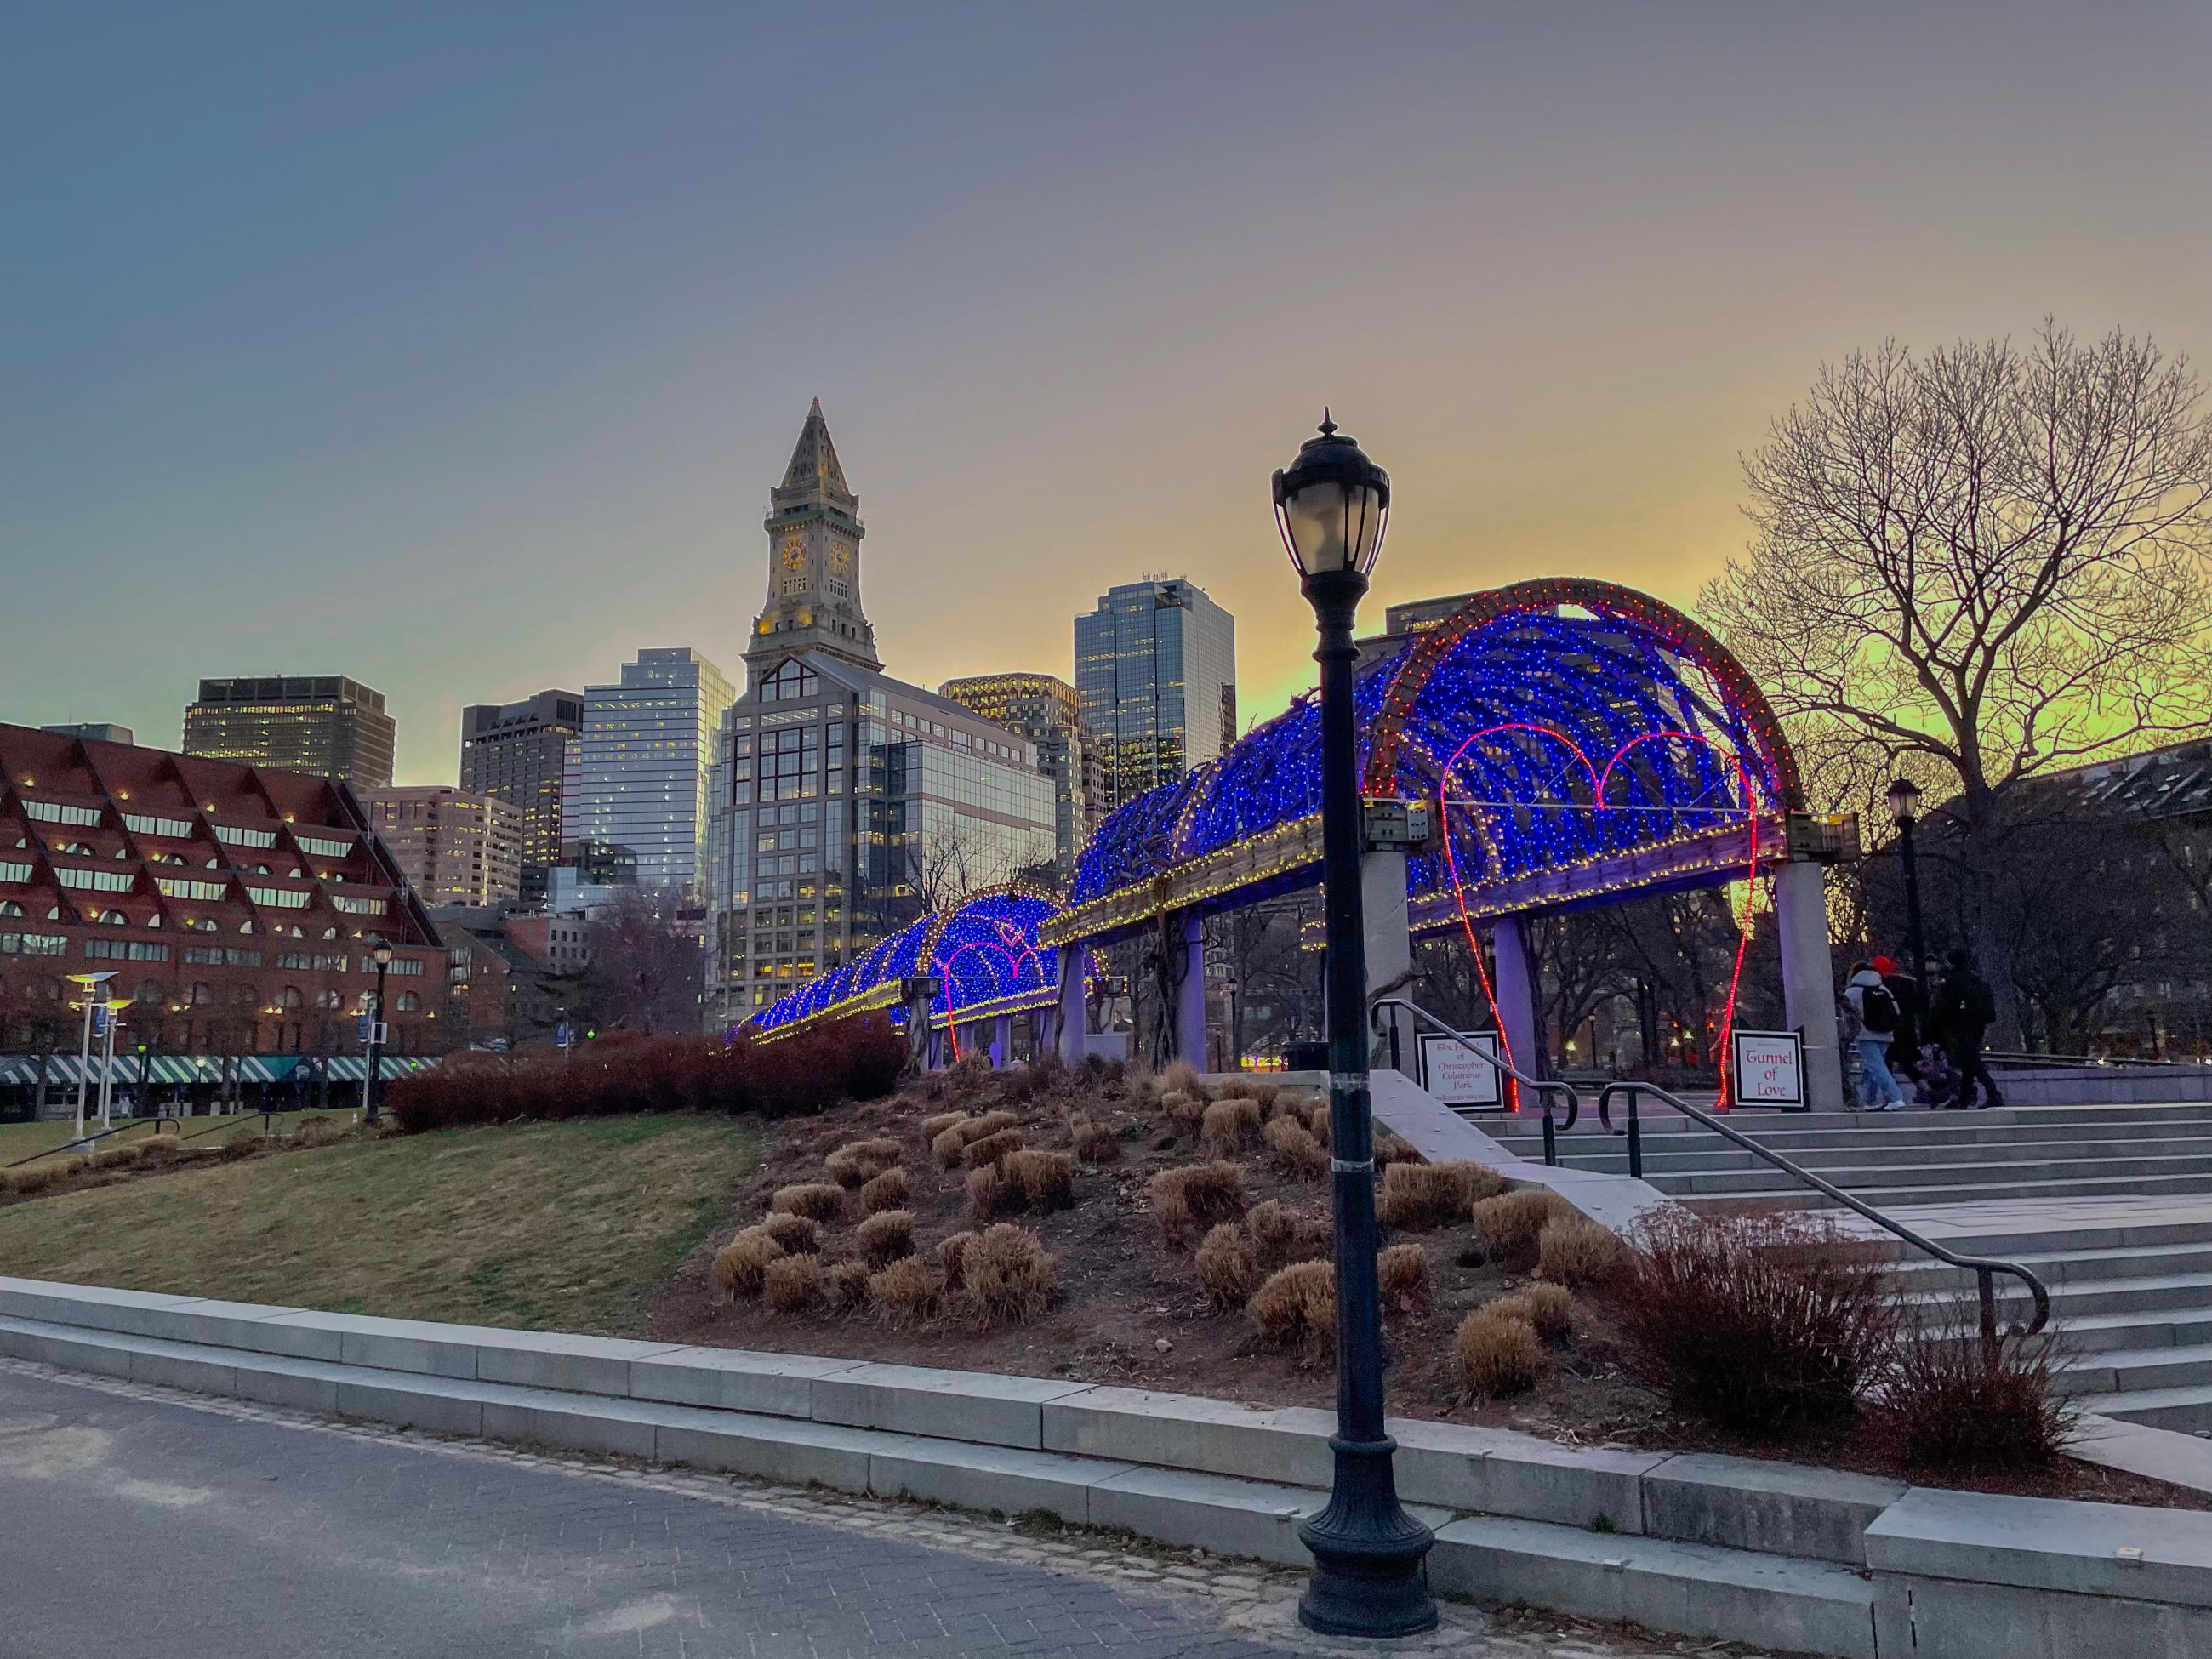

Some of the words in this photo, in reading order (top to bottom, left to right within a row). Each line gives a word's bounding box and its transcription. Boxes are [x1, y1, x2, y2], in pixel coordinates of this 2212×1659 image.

[1745, 1050, 1793, 1065] Tunnel
[1438, 1062, 1484, 1071] Christopher
[1442, 1070, 1481, 1080] Columbus
[1764, 1066, 1779, 1080] of
[1453, 1081, 1473, 1090] Park
[1757, 1082, 1786, 1097] Love
